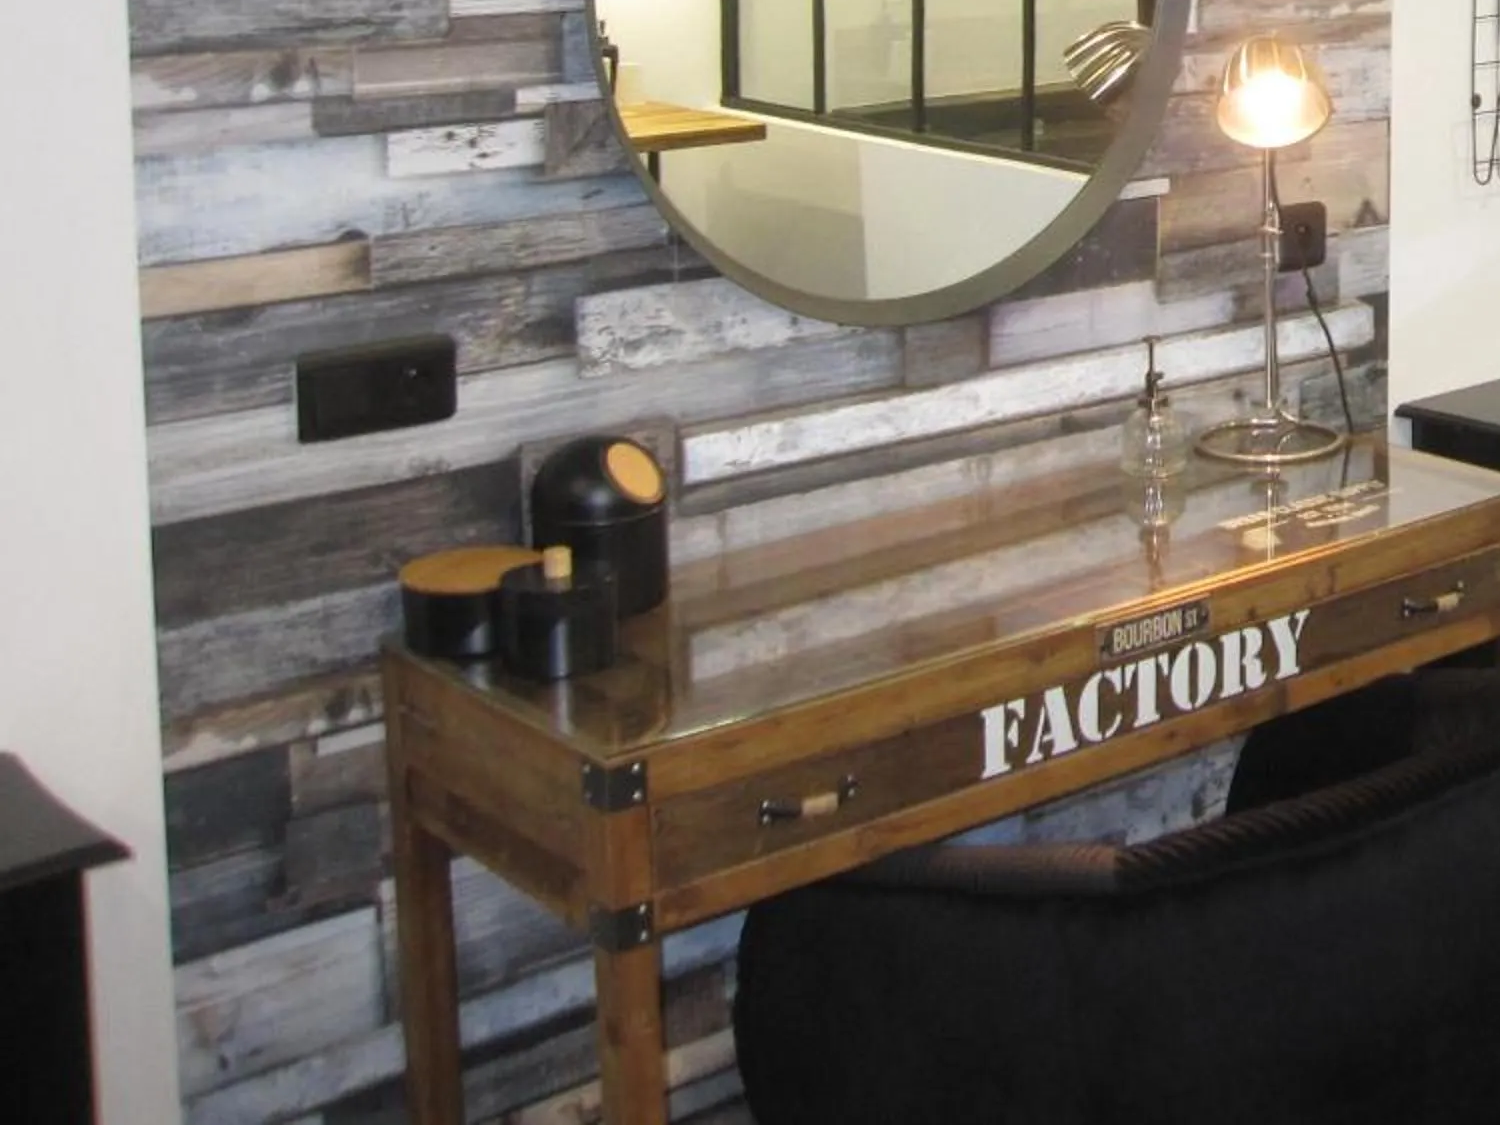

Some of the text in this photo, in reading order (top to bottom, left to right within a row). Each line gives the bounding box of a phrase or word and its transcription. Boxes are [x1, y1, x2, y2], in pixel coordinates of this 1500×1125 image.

[1113, 608, 1198, 654] BOURBON ST
[980, 609, 1311, 780] FACTORY
